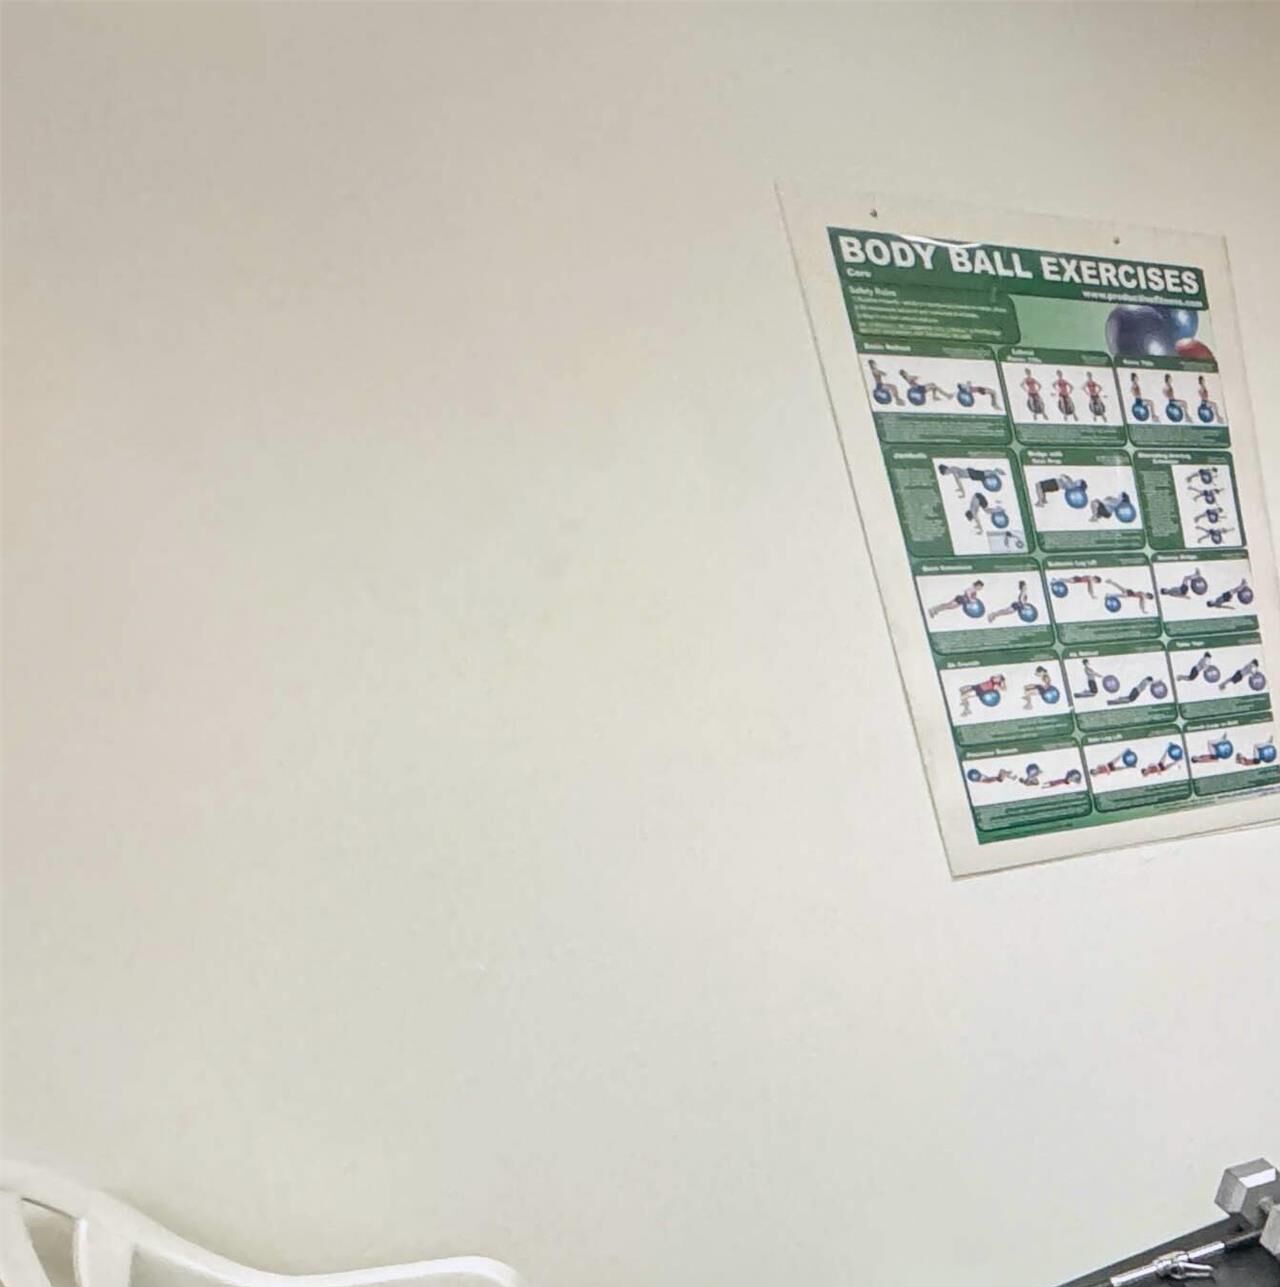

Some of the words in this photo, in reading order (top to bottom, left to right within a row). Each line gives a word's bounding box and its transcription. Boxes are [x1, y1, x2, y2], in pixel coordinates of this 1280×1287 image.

[838, 235, 936, 270] BODY
[948, 246, 1034, 279] BALL
[1039, 256, 1200, 295] EXERCISES
